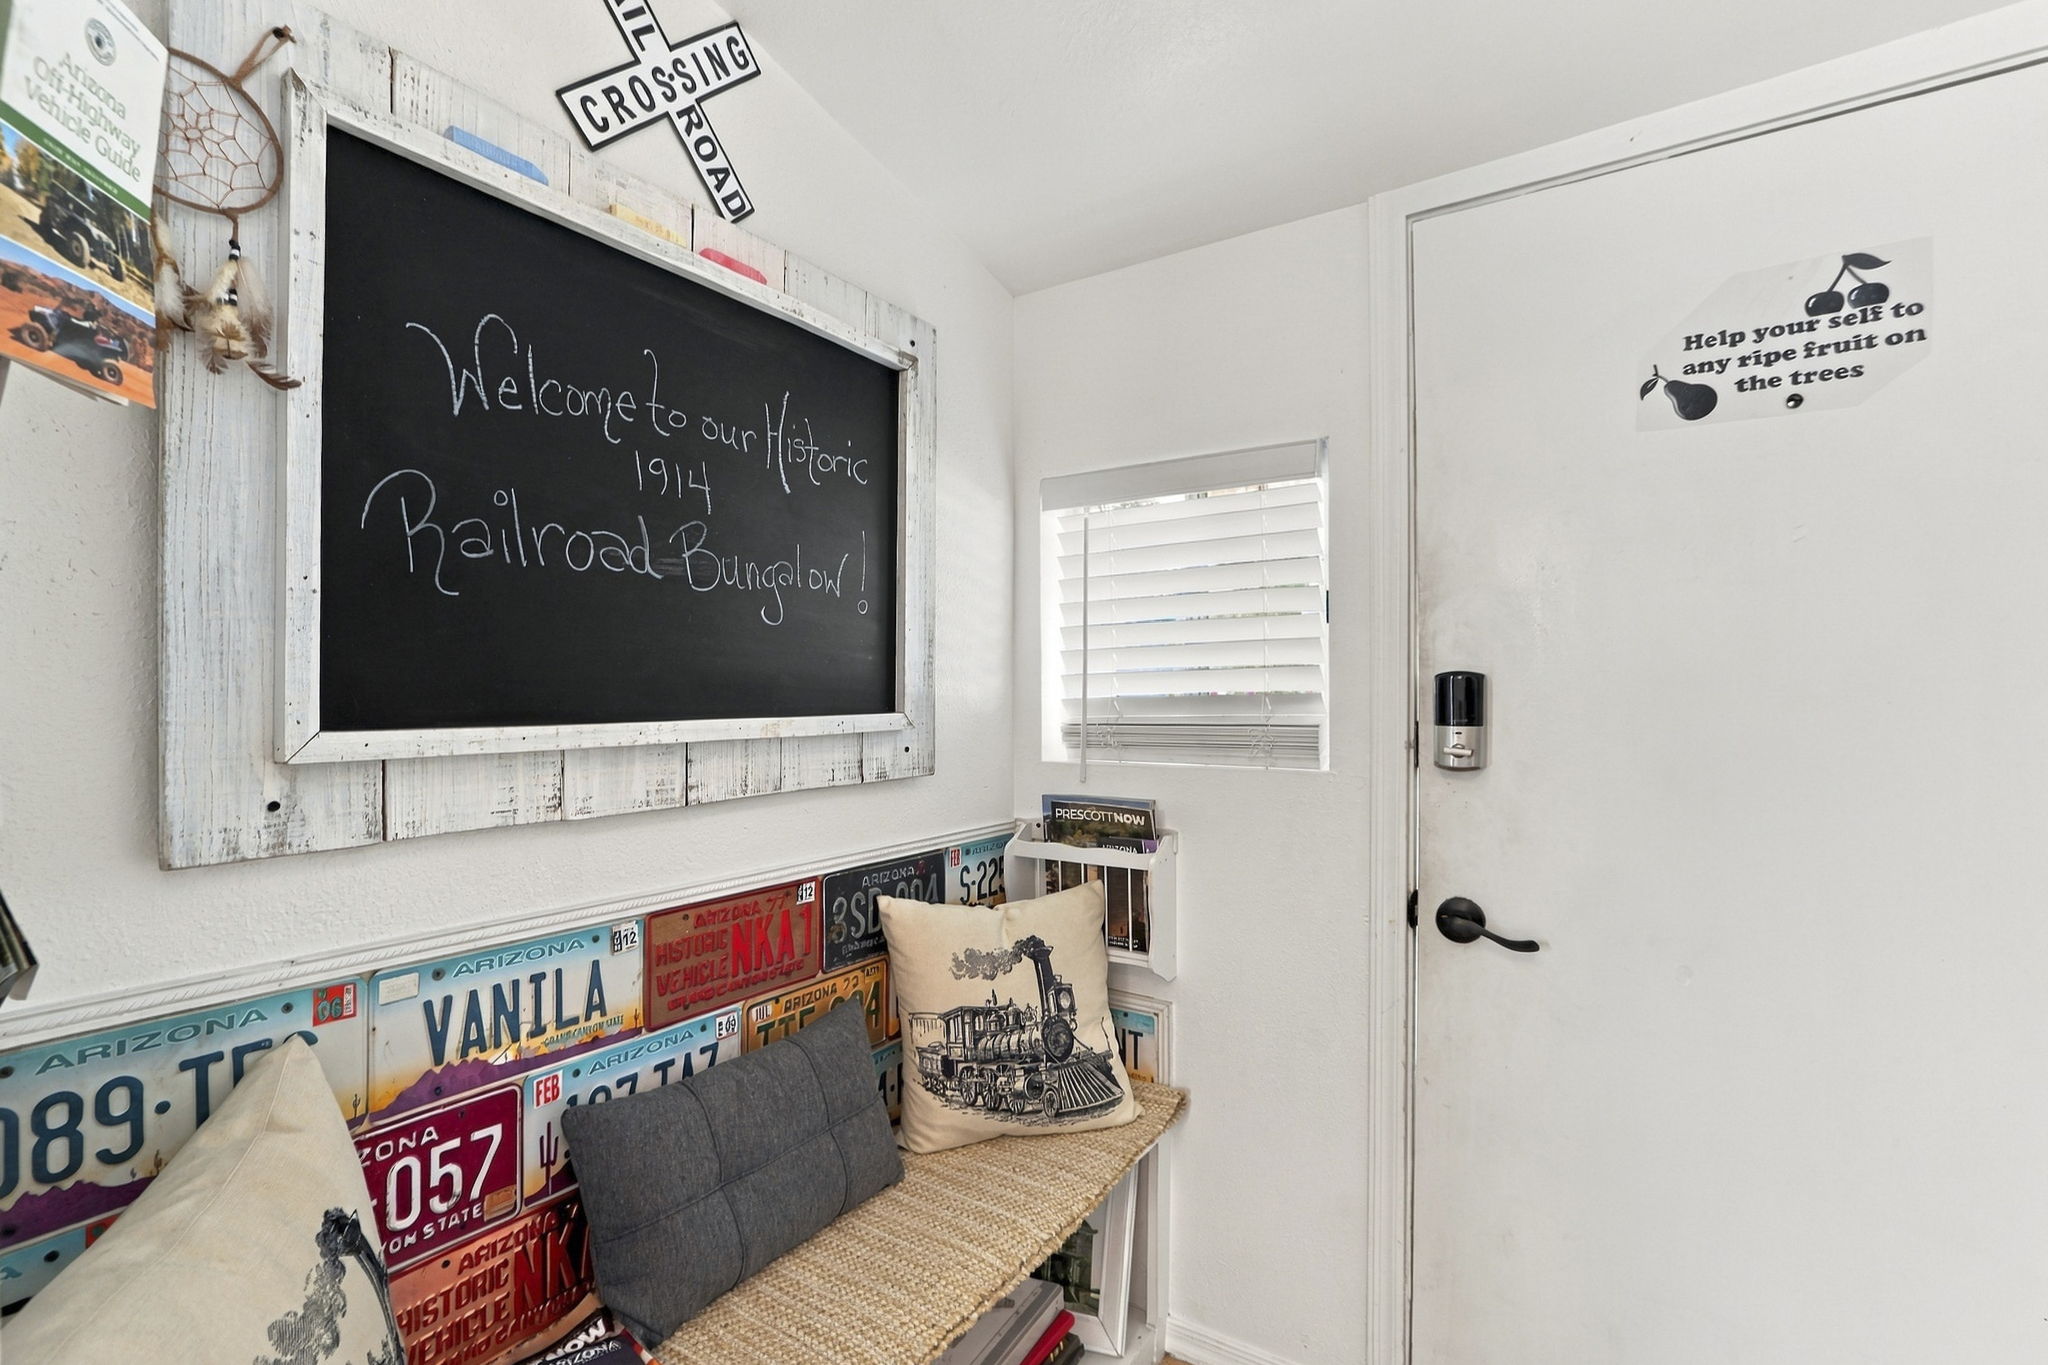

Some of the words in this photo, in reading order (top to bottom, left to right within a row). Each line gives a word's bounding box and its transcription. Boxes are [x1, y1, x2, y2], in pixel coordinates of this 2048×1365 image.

[60, 52, 127, 120] Arizona
[579, 35, 750, 134] CROSSING
[24, 75, 91, 145] Vehicle
[95, 136, 141, 183] Guide
[676, 104, 747, 217] ROAD
[1682, 355, 1732, 376] any
[1738, 347, 1798, 369] ripe
[1803, 332, 1878, 359] fruit
[1885, 327, 1928, 346] on
[1683, 329, 1747, 352] Help
[1752, 316, 1821, 344] your
[1828, 303, 1883, 329] self
[1890, 301, 1925, 319] to
[405, 313, 637, 444] Welcome
[643, 349, 688, 437] to
[702, 415, 756, 452] our
[765, 391, 869, 494] Historic
[1733, 374, 1782, 394] the
[1789, 363, 1865, 387] trees
[635, 450, 713, 516] 1914
[360, 468, 666, 597] Railroad
[452, 937, 586, 979] ARIZONA
[622, 930, 638, 947] 12
[655, 951, 729, 998] VEHICLE
[783, 982, 838, 1014] ARIZONA
[423, 959, 608, 1067] VANILA
[35, 1006, 270, 1077] ARIZONA
[588, 1030, 695, 1076] ARIZONA
[535, 1073, 560, 1108] FEB
[422, 1202, 484, 1240] STATE
